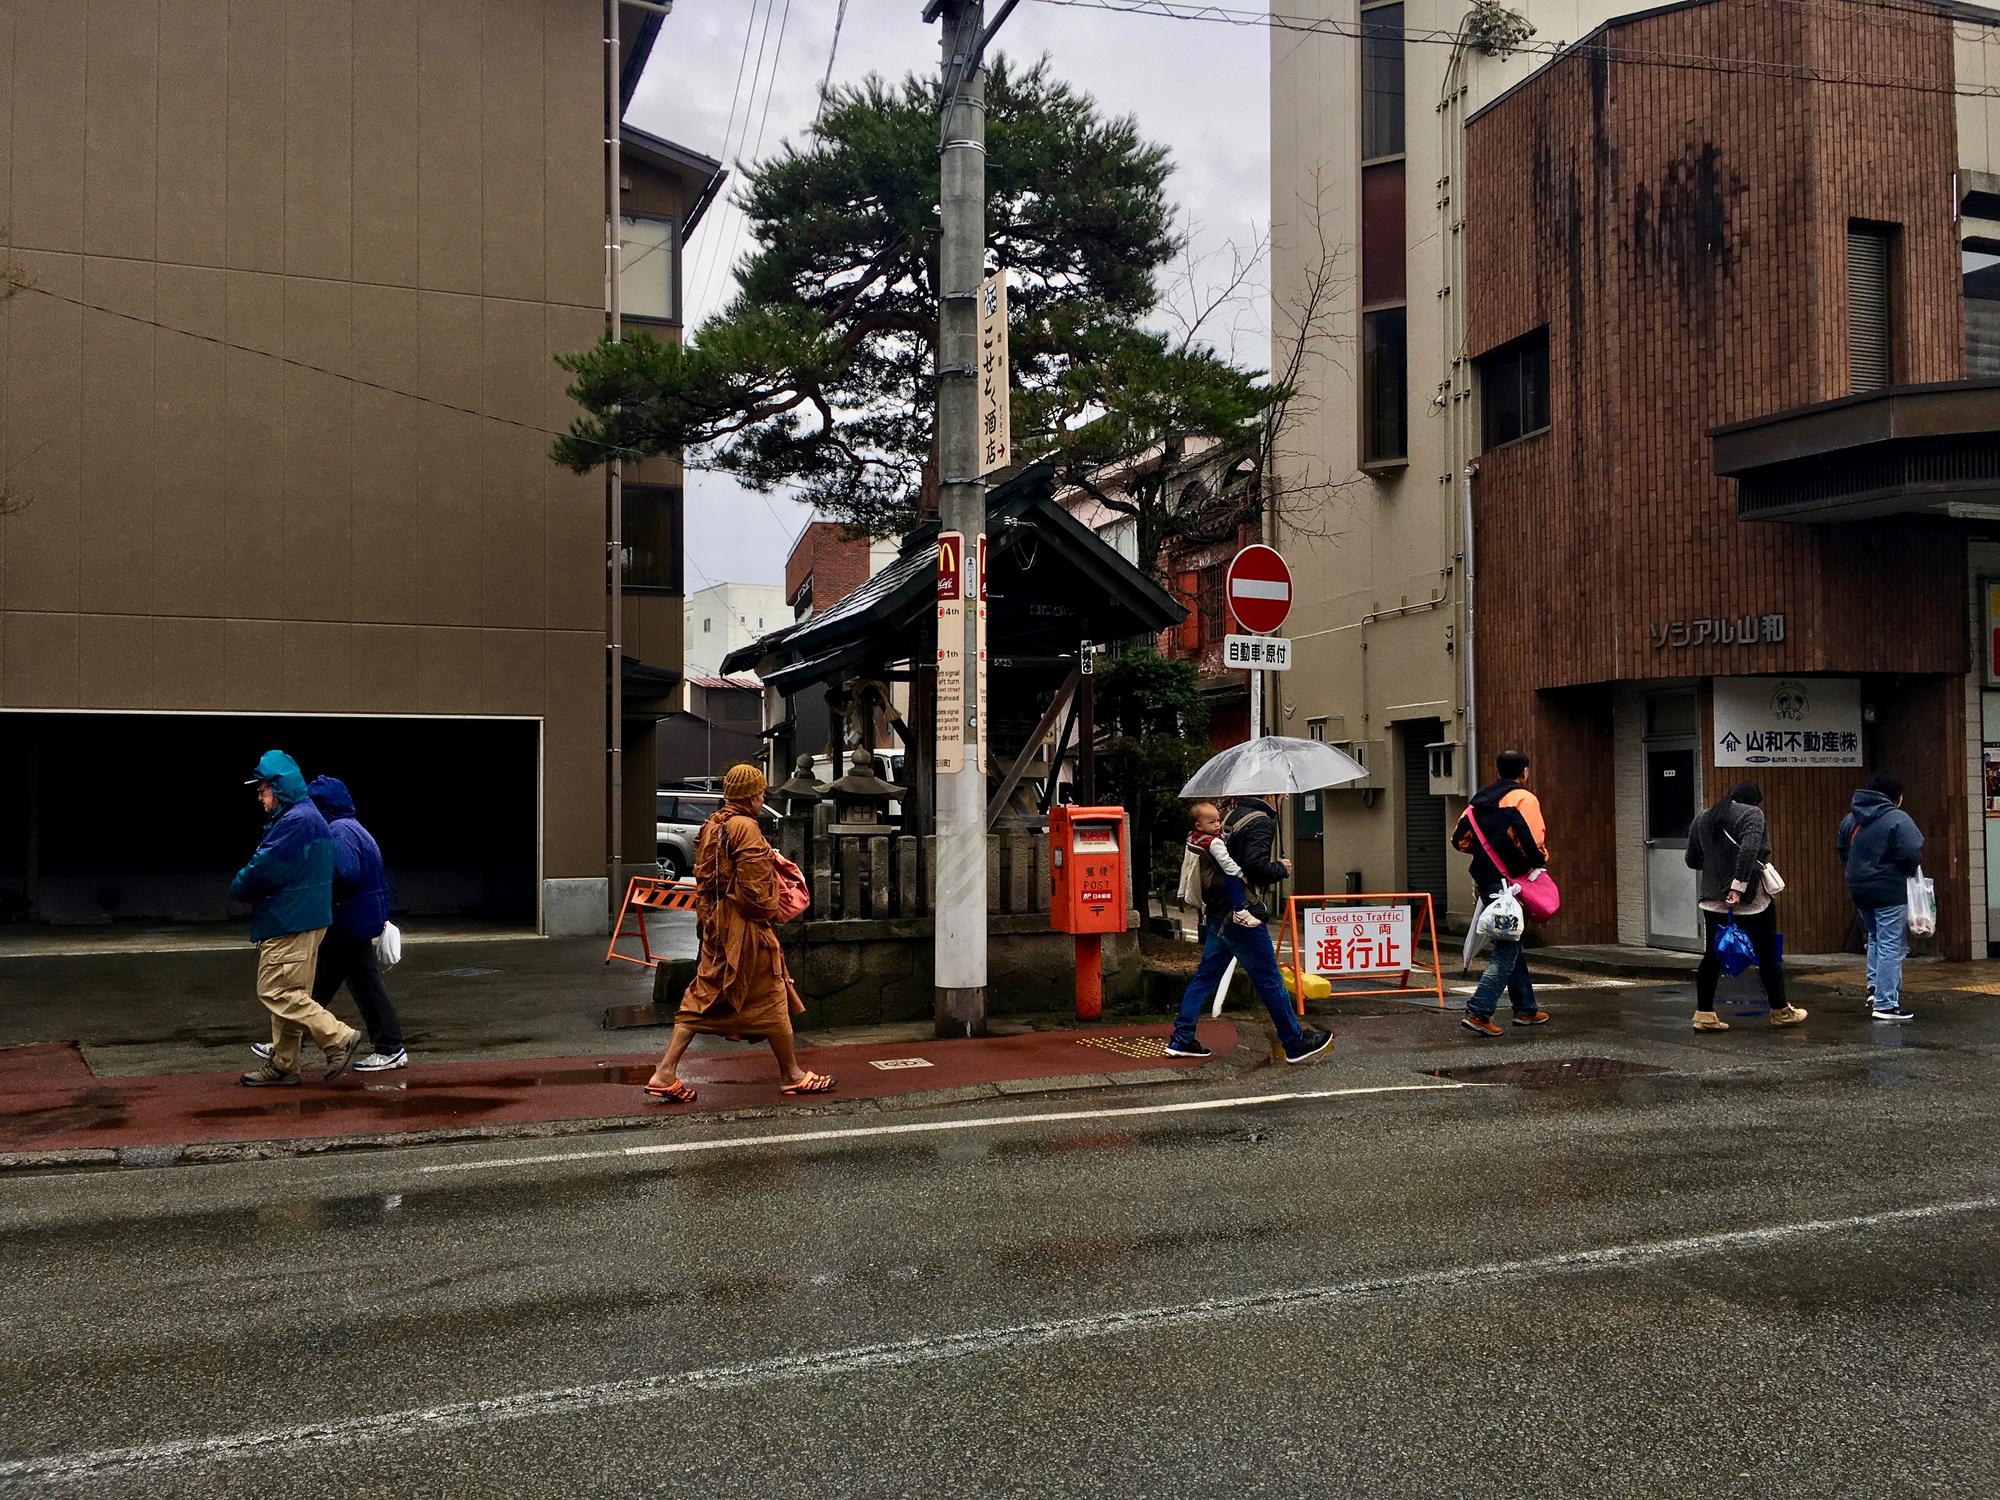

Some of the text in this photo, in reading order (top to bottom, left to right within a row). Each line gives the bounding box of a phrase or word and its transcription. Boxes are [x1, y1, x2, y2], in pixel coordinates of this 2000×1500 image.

[983, 326, 997, 465] こせとく酒店
[945, 608, 960, 616] 4th
[1650, 613, 1785, 648] ソシアル山和
[1229, 642, 1287, 663] 自動車・原付
[1083, 880, 1110, 890] POST
[1315, 911, 1401, 923] Closed to Traffic
[1316, 937, 1401, 970] 通行止
